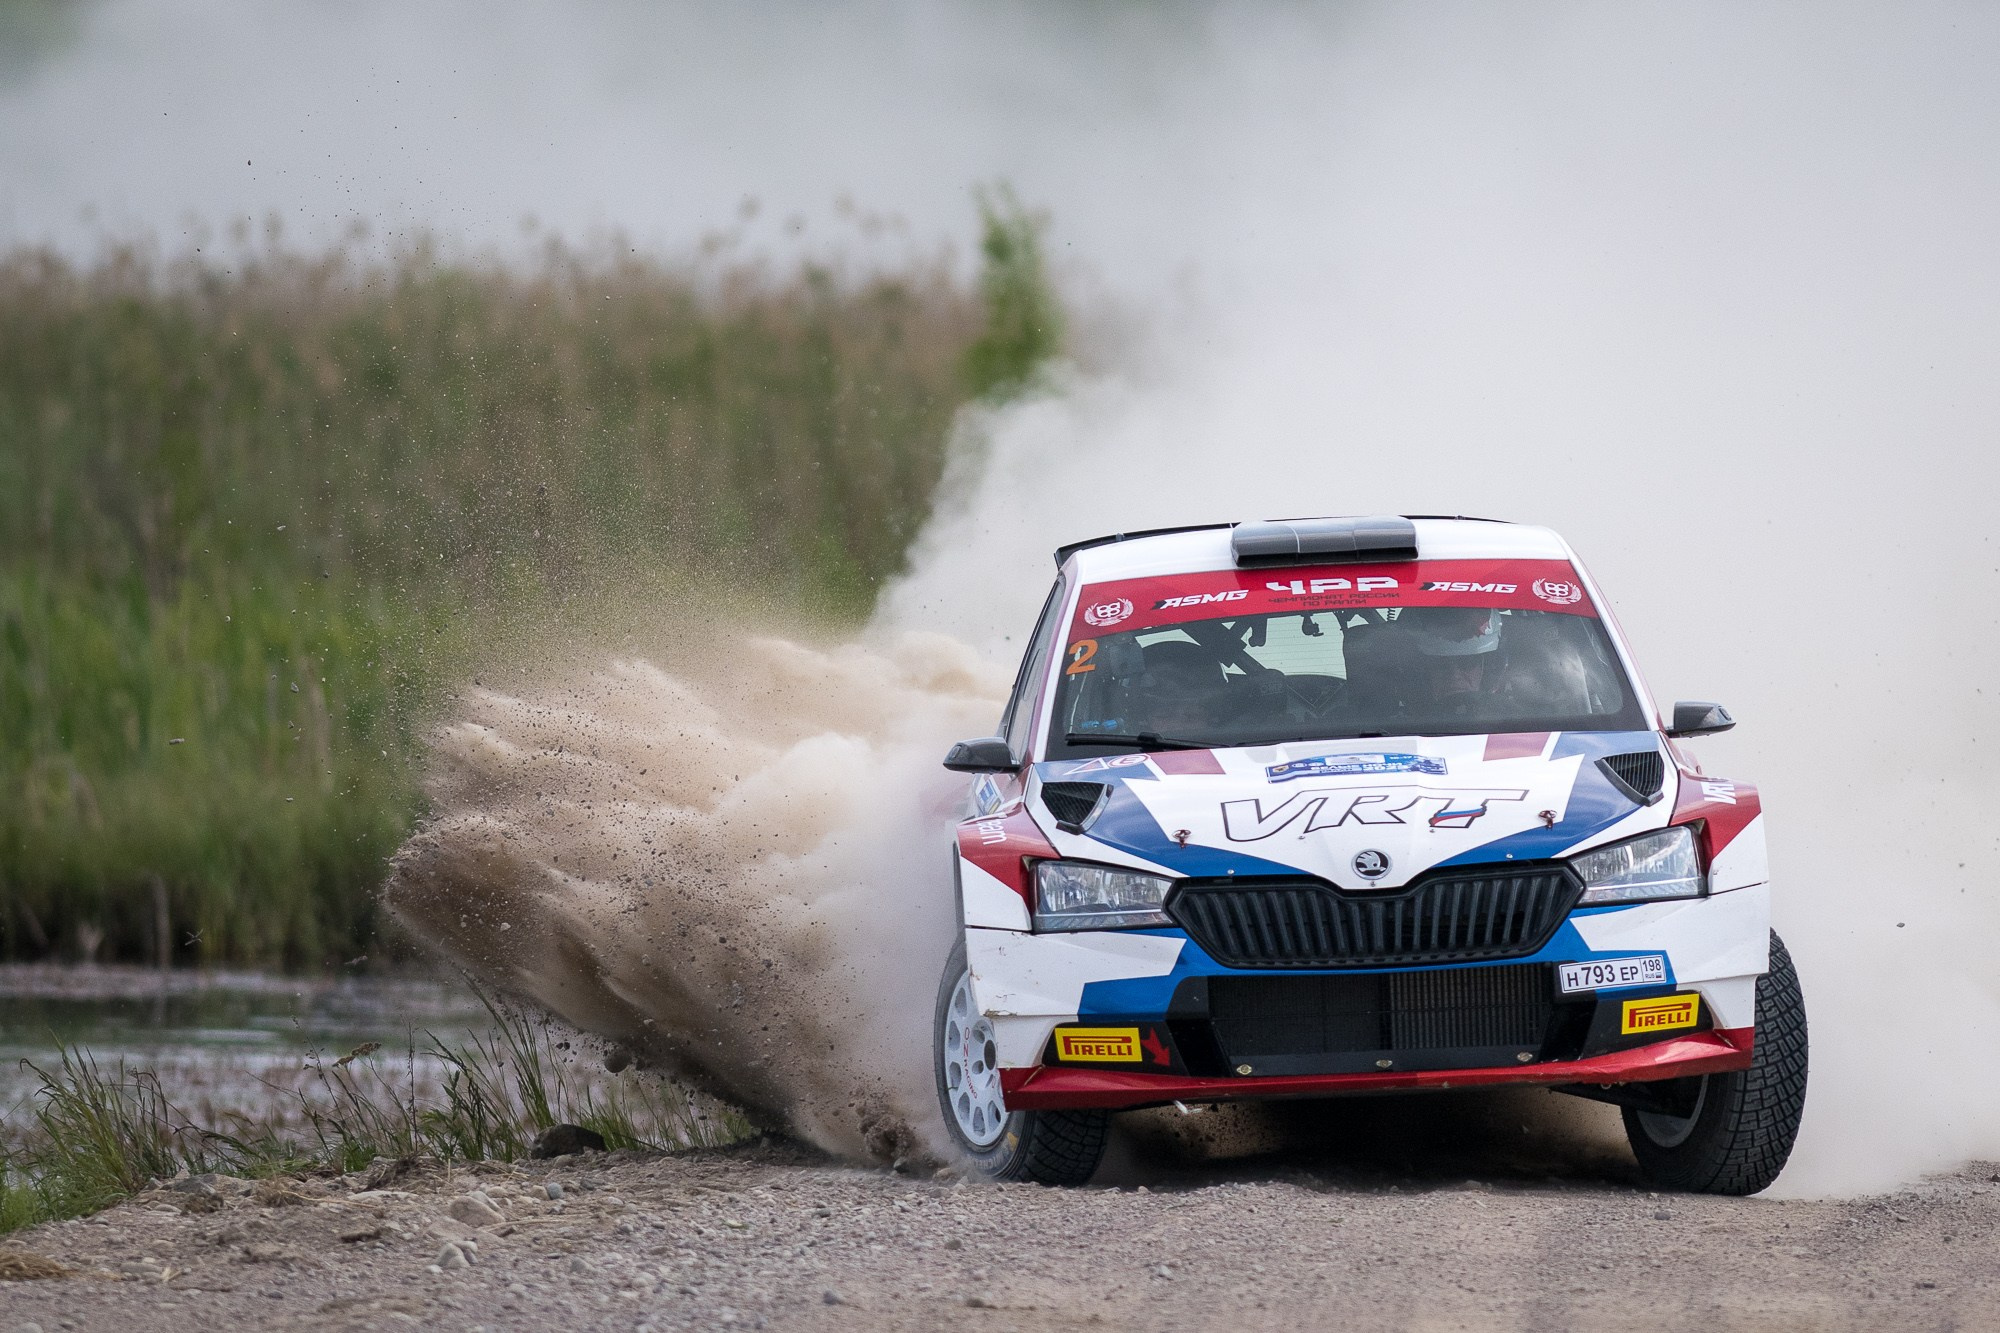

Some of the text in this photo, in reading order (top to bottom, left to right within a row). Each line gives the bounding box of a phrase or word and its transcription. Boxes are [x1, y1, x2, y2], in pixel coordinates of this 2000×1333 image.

[1428, 581, 1518, 594] ASMG
[1160, 589, 1249, 610] ASMG
[1066, 639, 1098, 675] 2
[1220, 785, 1530, 842] VRT
[1642, 958, 1662, 972] 198
[1629, 1002, 1692, 1029] PIRELLI
[1063, 1035, 1133, 1056] PIRELLI
